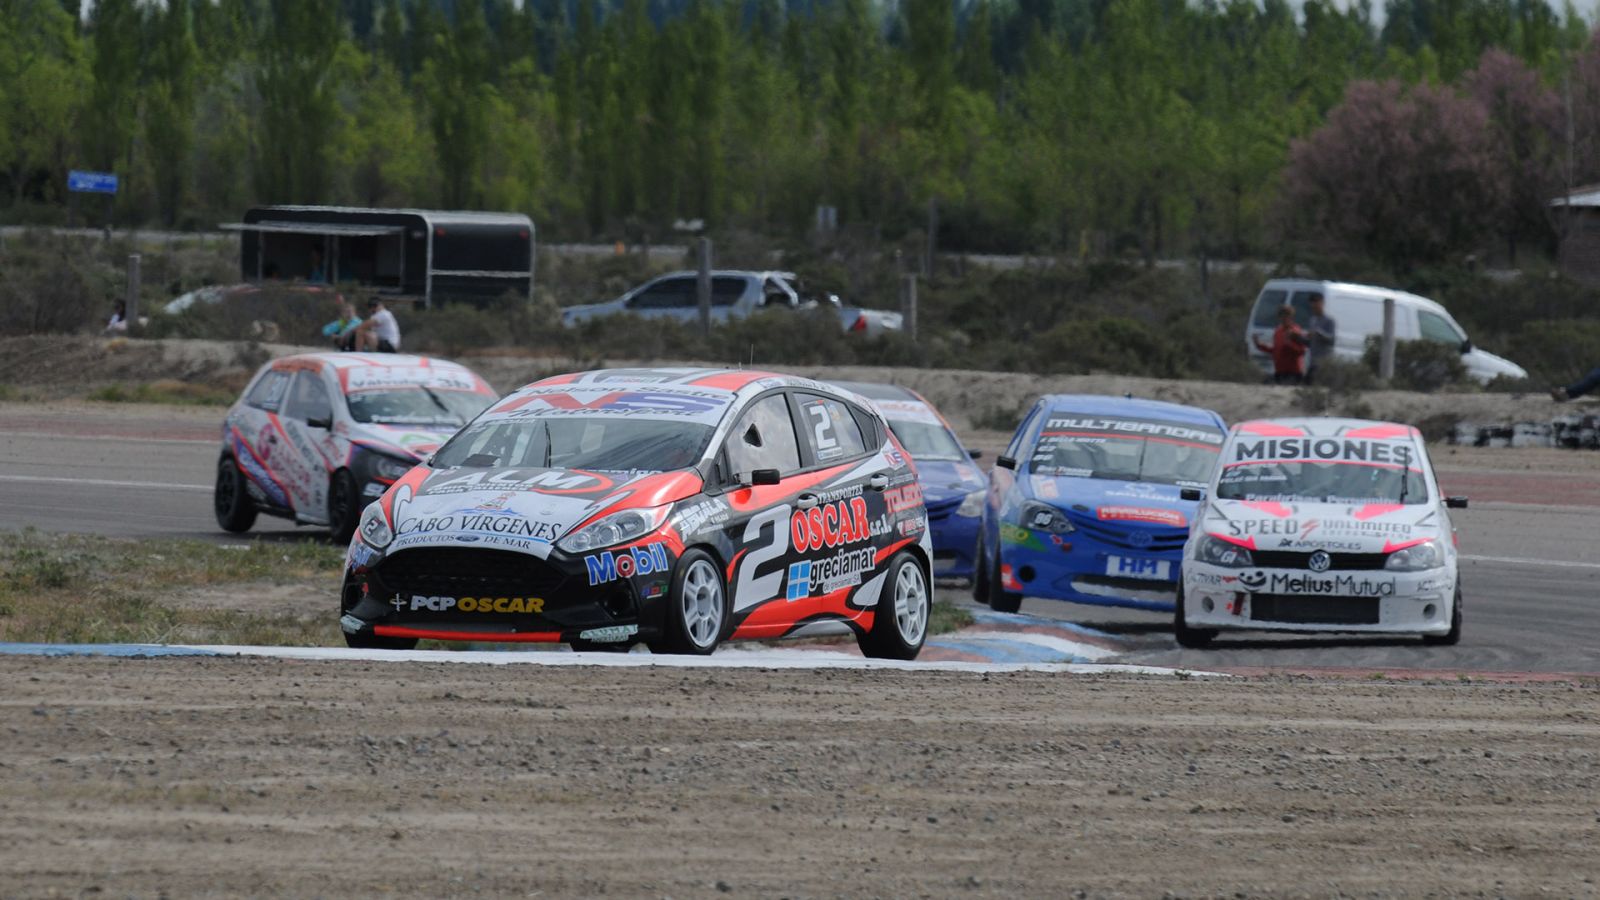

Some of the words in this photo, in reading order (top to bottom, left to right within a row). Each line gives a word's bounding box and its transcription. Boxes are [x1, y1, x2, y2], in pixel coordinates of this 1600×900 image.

[529, 387, 603, 395] Nelson
[639, 387, 729, 400] Sastre
[510, 407, 700, 418] Motorsport
[809, 404, 837, 449] 2
[1046, 418, 1223, 445] MULTIBANDAS
[1235, 438, 1413, 466] MISIONES
[818, 484, 864, 505] TRANSPORTES
[399, 517, 454, 536] CABO
[460, 513, 564, 542] VÍRGENES
[791, 496, 870, 554] OSCAR
[1229, 519, 1298, 536] SPEED
[1322, 519, 1412, 534] UNLIMITED
[397, 534, 455, 547] PRODUCTOS
[484, 536, 503, 546] DE
[506, 538, 531, 549] MAR
[583, 542, 669, 586] Mobil
[732, 503, 792, 614] 2
[809, 547, 876, 589] greciamar
[1118, 557, 1158, 575] HM
[1270, 574, 1334, 594] Melius
[1335, 574, 1396, 596] Mutual
[410, 595, 457, 611] PCP
[457, 596, 545, 613] OSCAR
